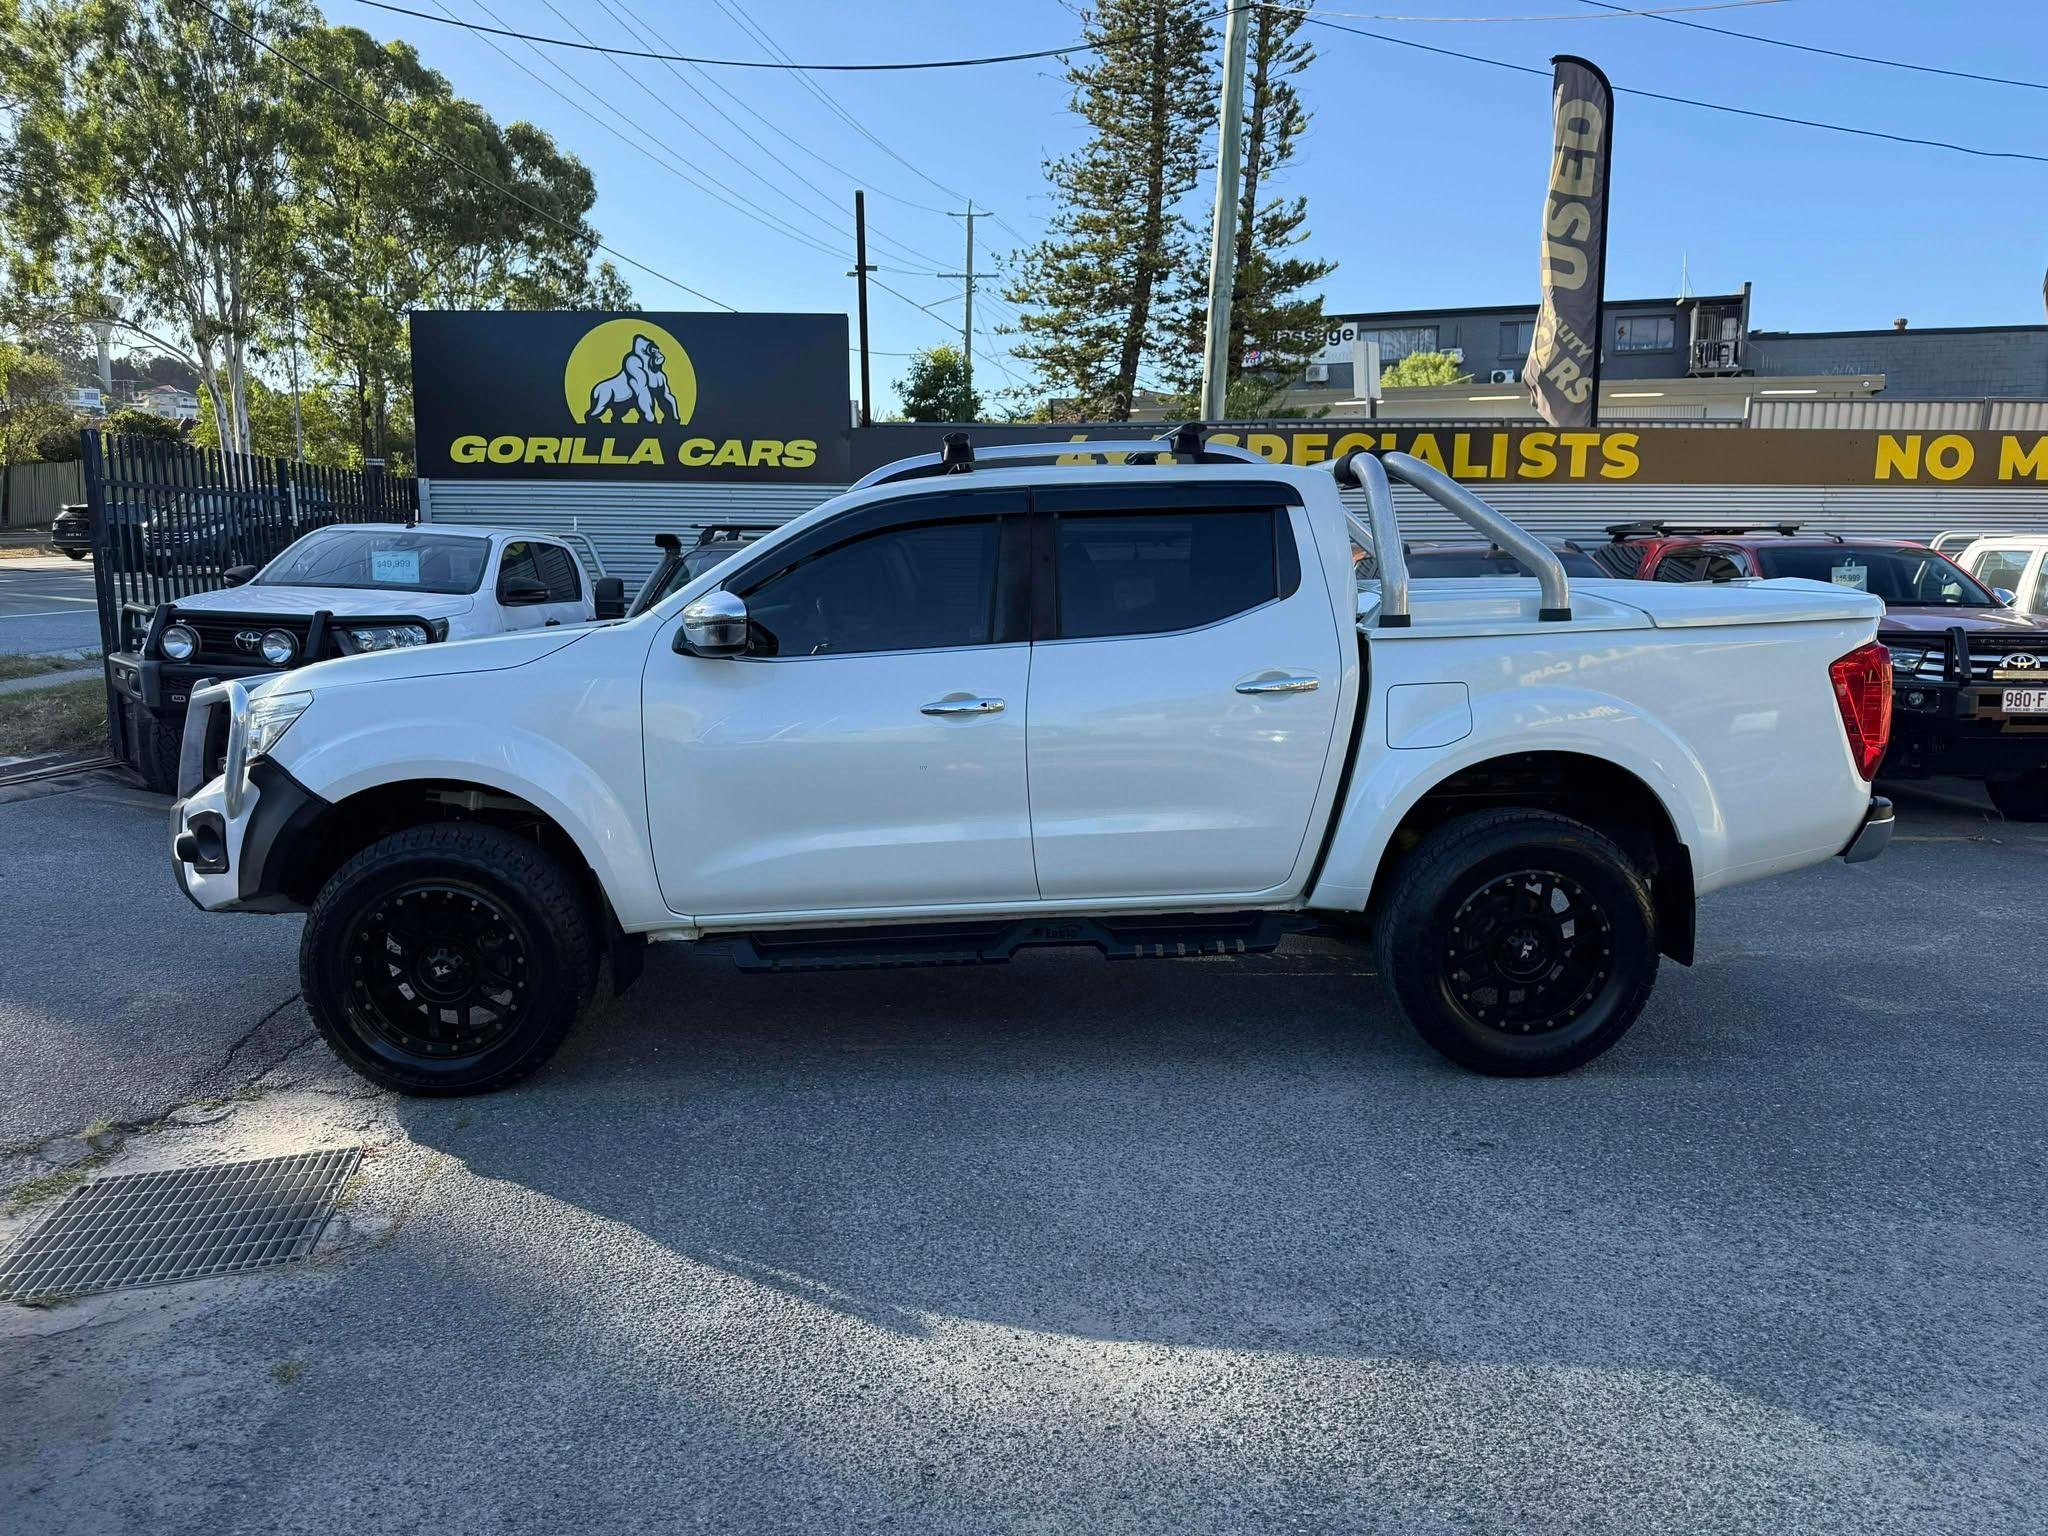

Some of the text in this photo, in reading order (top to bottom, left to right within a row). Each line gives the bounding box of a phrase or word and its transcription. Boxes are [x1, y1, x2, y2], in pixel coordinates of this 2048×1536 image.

[1542, 99, 1602, 290] USED
[1273, 327, 1354, 346] assage
[450, 435, 817, 468] GORILLA CARS
[1874, 434, 1975, 481] NO
